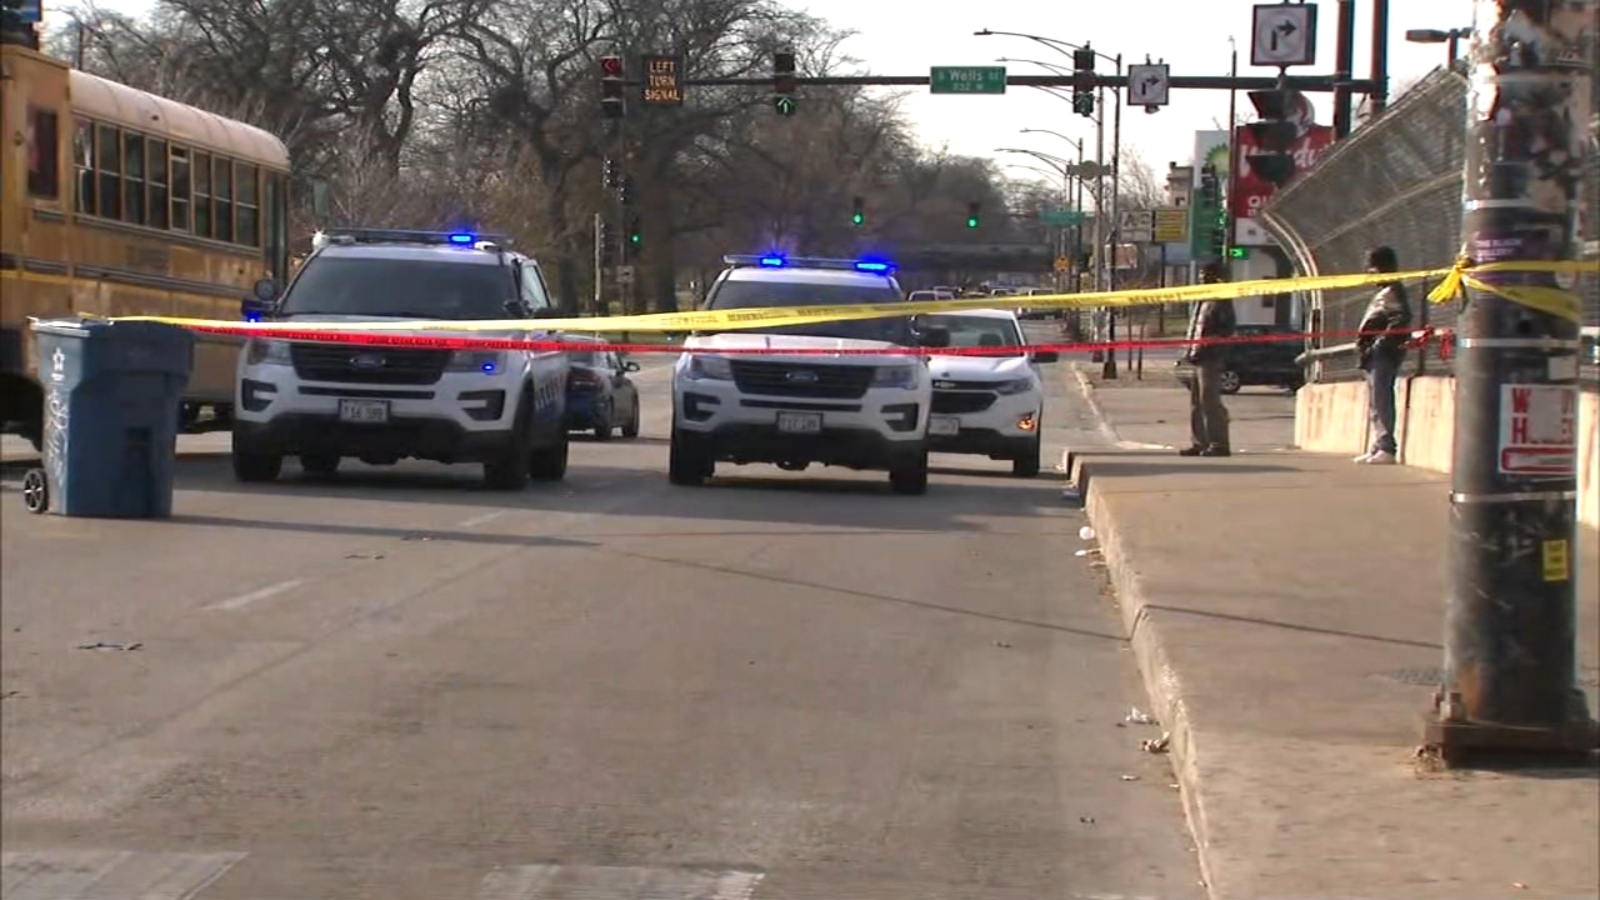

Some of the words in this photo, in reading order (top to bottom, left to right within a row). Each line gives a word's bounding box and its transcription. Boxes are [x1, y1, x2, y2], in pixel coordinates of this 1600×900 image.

[649, 60, 675, 73] LEFT
[649, 75, 676, 87] TURN
[949, 69, 983, 81] Wells
[644, 89, 681, 101] SIGNAL
